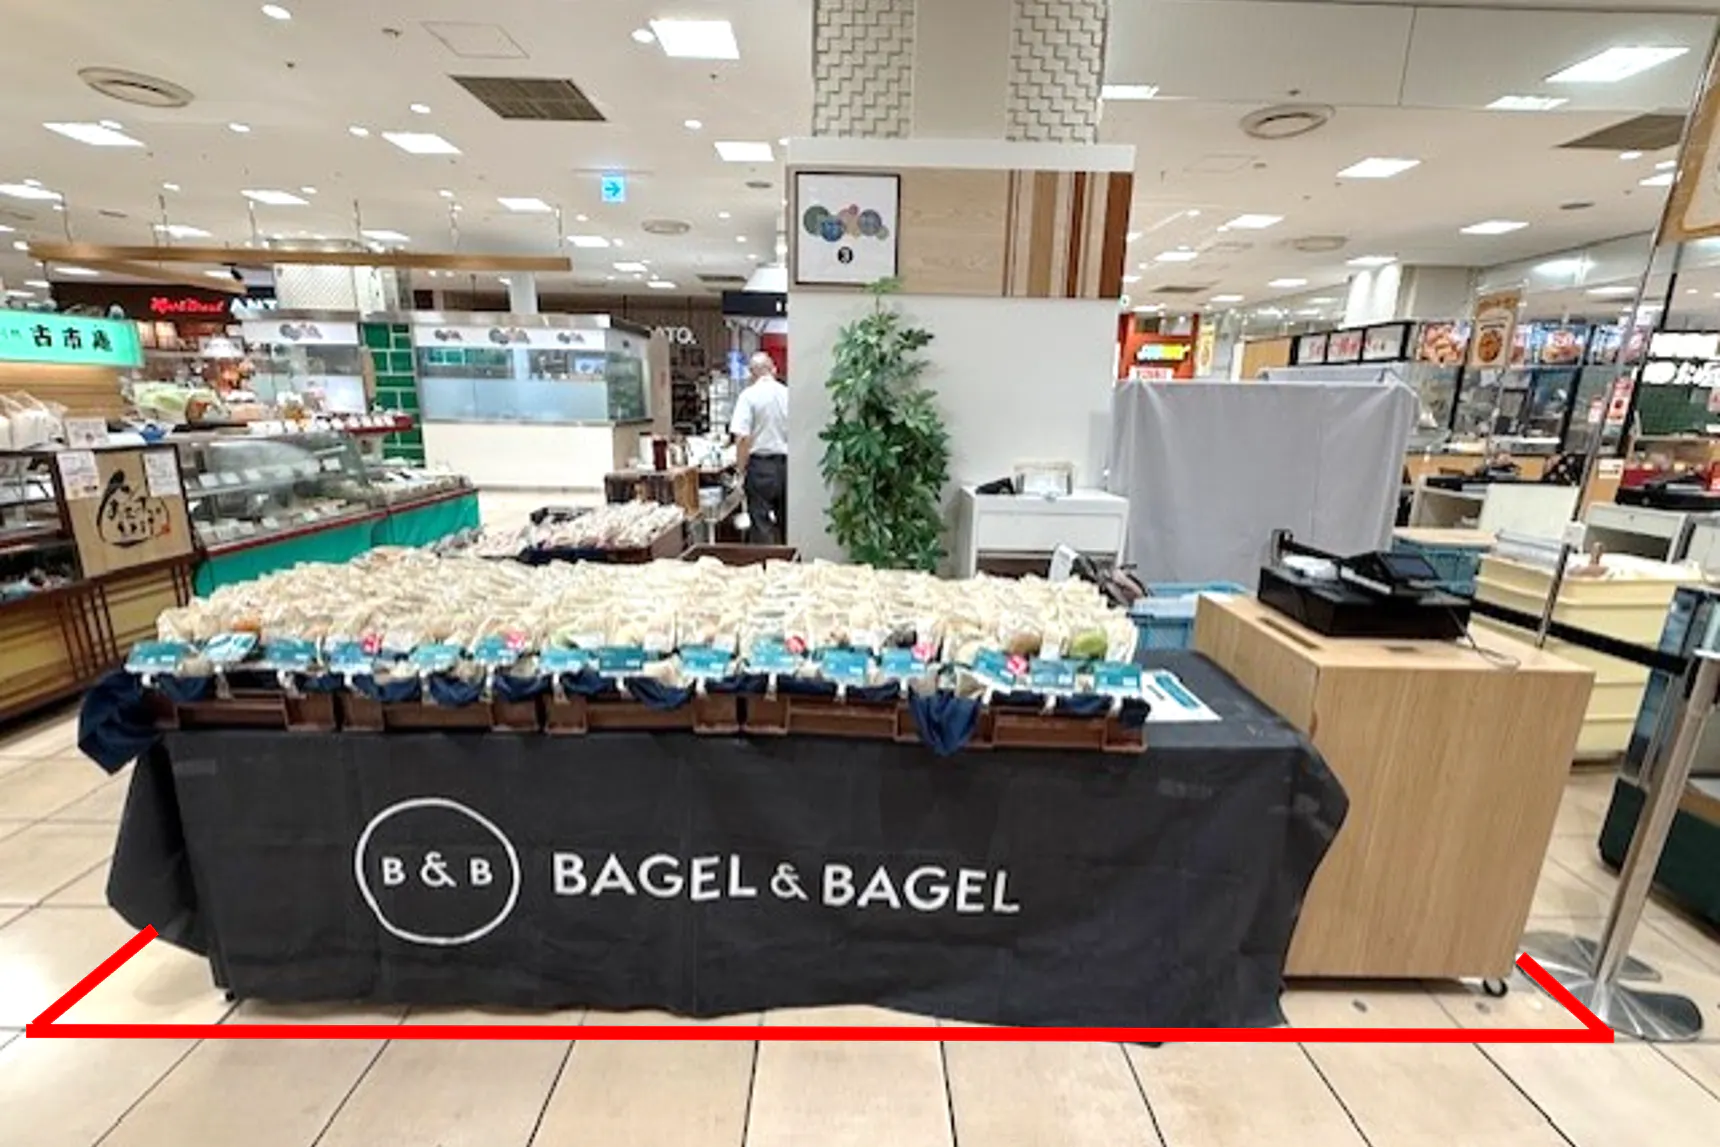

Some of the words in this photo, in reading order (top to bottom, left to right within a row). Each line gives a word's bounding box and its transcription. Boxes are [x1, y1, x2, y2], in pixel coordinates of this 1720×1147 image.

[382, 856, 406, 885] B
[420, 851, 457, 887] &
[470, 858, 493, 886] B
[553, 852, 758, 901] BAGEL
[770, 863, 808, 900] &
[823, 864, 1020, 913] BAGEL
